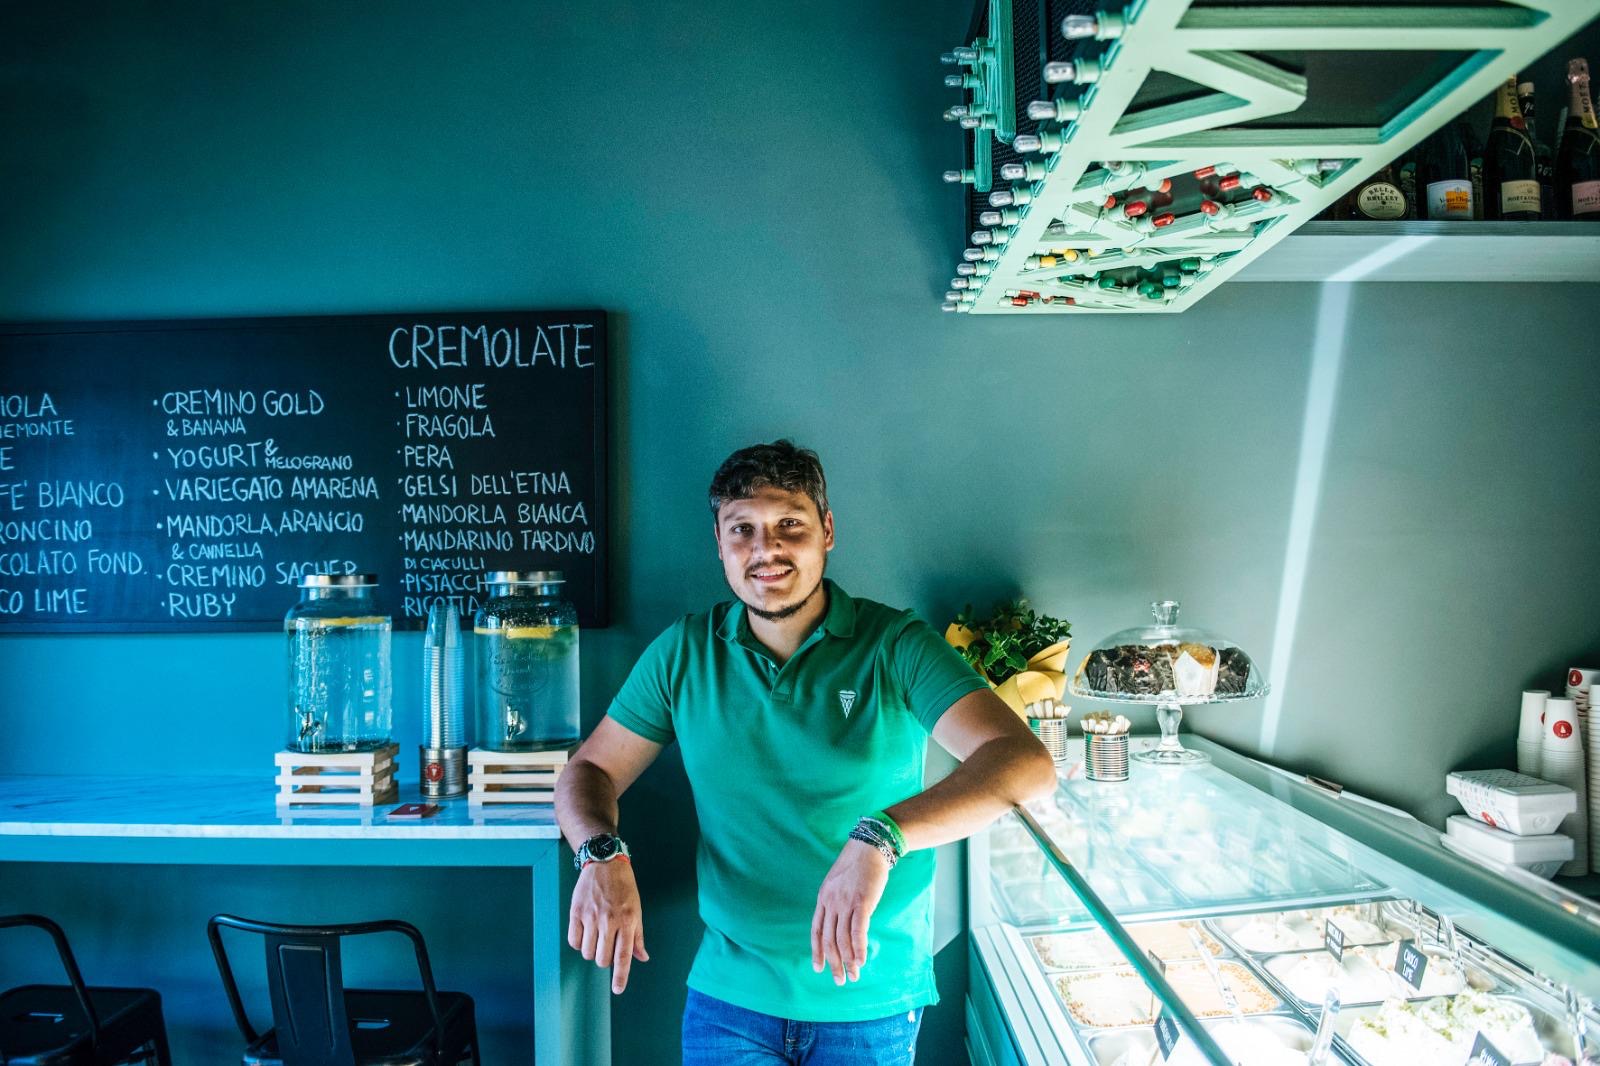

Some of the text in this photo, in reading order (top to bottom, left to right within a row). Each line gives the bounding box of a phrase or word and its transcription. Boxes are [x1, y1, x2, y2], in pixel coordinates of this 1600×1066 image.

[389, 324, 594, 369] CREMOLATE
[1, 393, 57, 417] IOLA
[162, 389, 324, 416] CREMINO GOLD
[406, 384, 487, 409] LIMONE
[167, 417, 246, 436] & BANANA
[406, 414, 495, 439] FRAGOLA
[168, 439, 352, 470] YOGURT & MELOGRANO
[405, 444, 453, 469] PERA
[39, 480, 124, 508] BIANCO
[165, 476, 379, 501] VARIEGATO AMARENA
[405, 471, 571, 497] GELSI DELL'ETNA
[403, 502, 587, 525] MANDORLA BIANCA
[172, 542, 263, 560] & CANNELLA
[405, 530, 594, 553] MANDARINO TARDIVO
[0, 549, 147, 576] COLATO FOND.
[404, 557, 484, 571] DI CIACULLI
[167, 564, 265, 587] CREMINO
[405, 572, 489, 595] PISTACCH
[35, 589, 87, 613] LIME
[169, 593, 235, 617] RUBY
